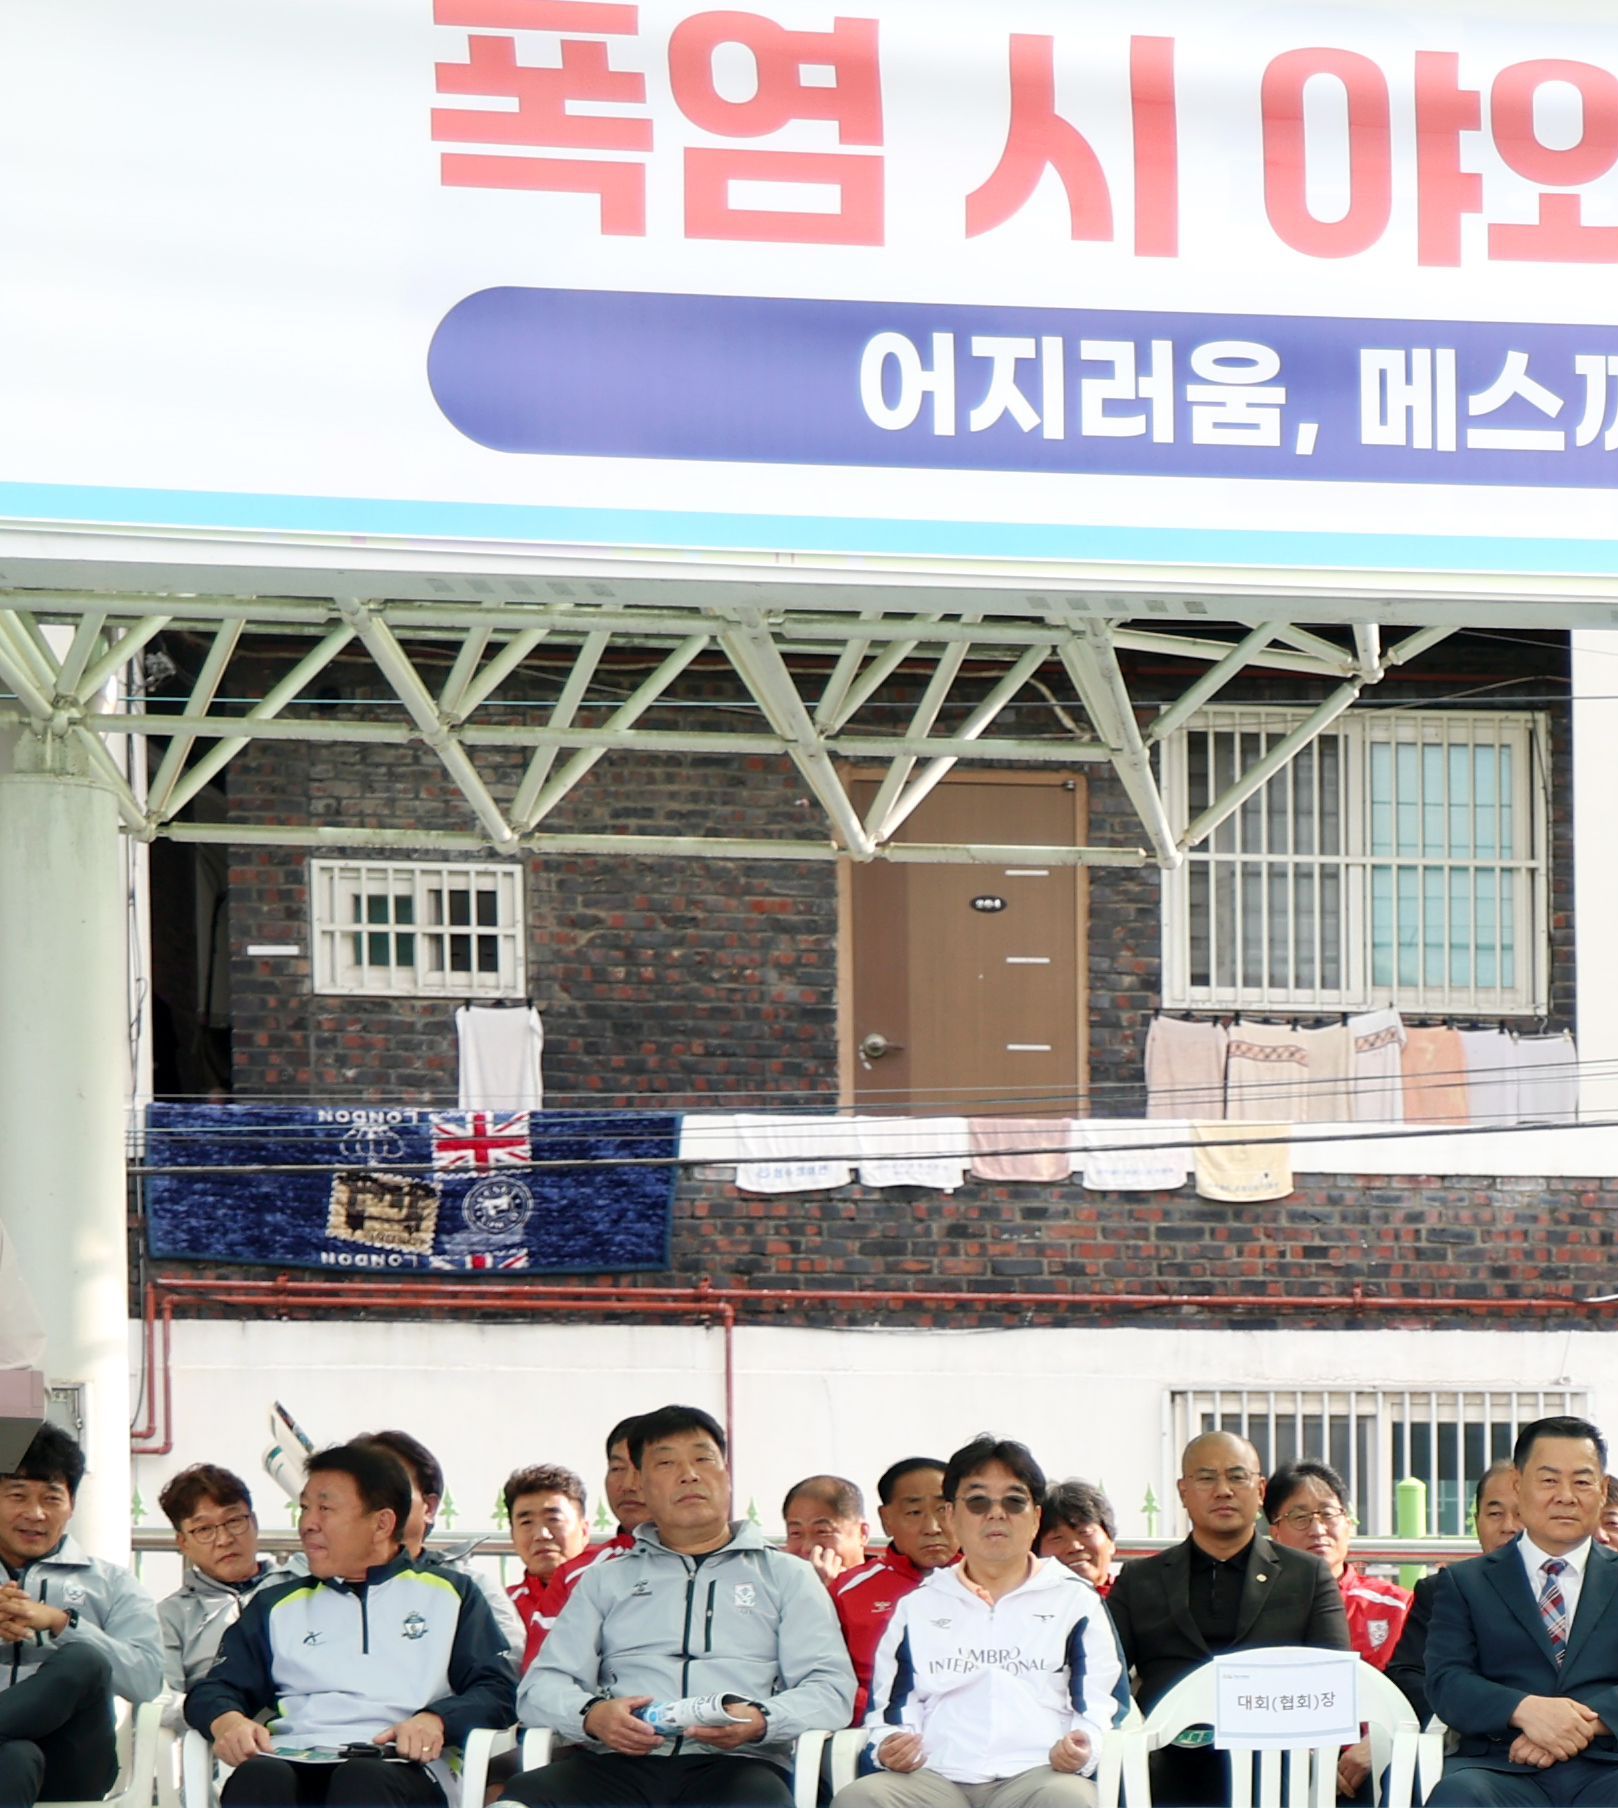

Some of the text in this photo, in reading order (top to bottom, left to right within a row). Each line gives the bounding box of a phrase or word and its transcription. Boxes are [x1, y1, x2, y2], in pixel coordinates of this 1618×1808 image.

[431, 0, 885, 246] 폭염
[966, 34, 1178, 257] 시
[860, 330, 1320, 455] 어지러움,
[318, 1109, 419, 1124] LONDON
[321, 1251, 419, 1267] LONDON
[929, 1657, 1048, 1677] INTERONAL
[1237, 1691, 1336, 1712] 대회(협회)장
